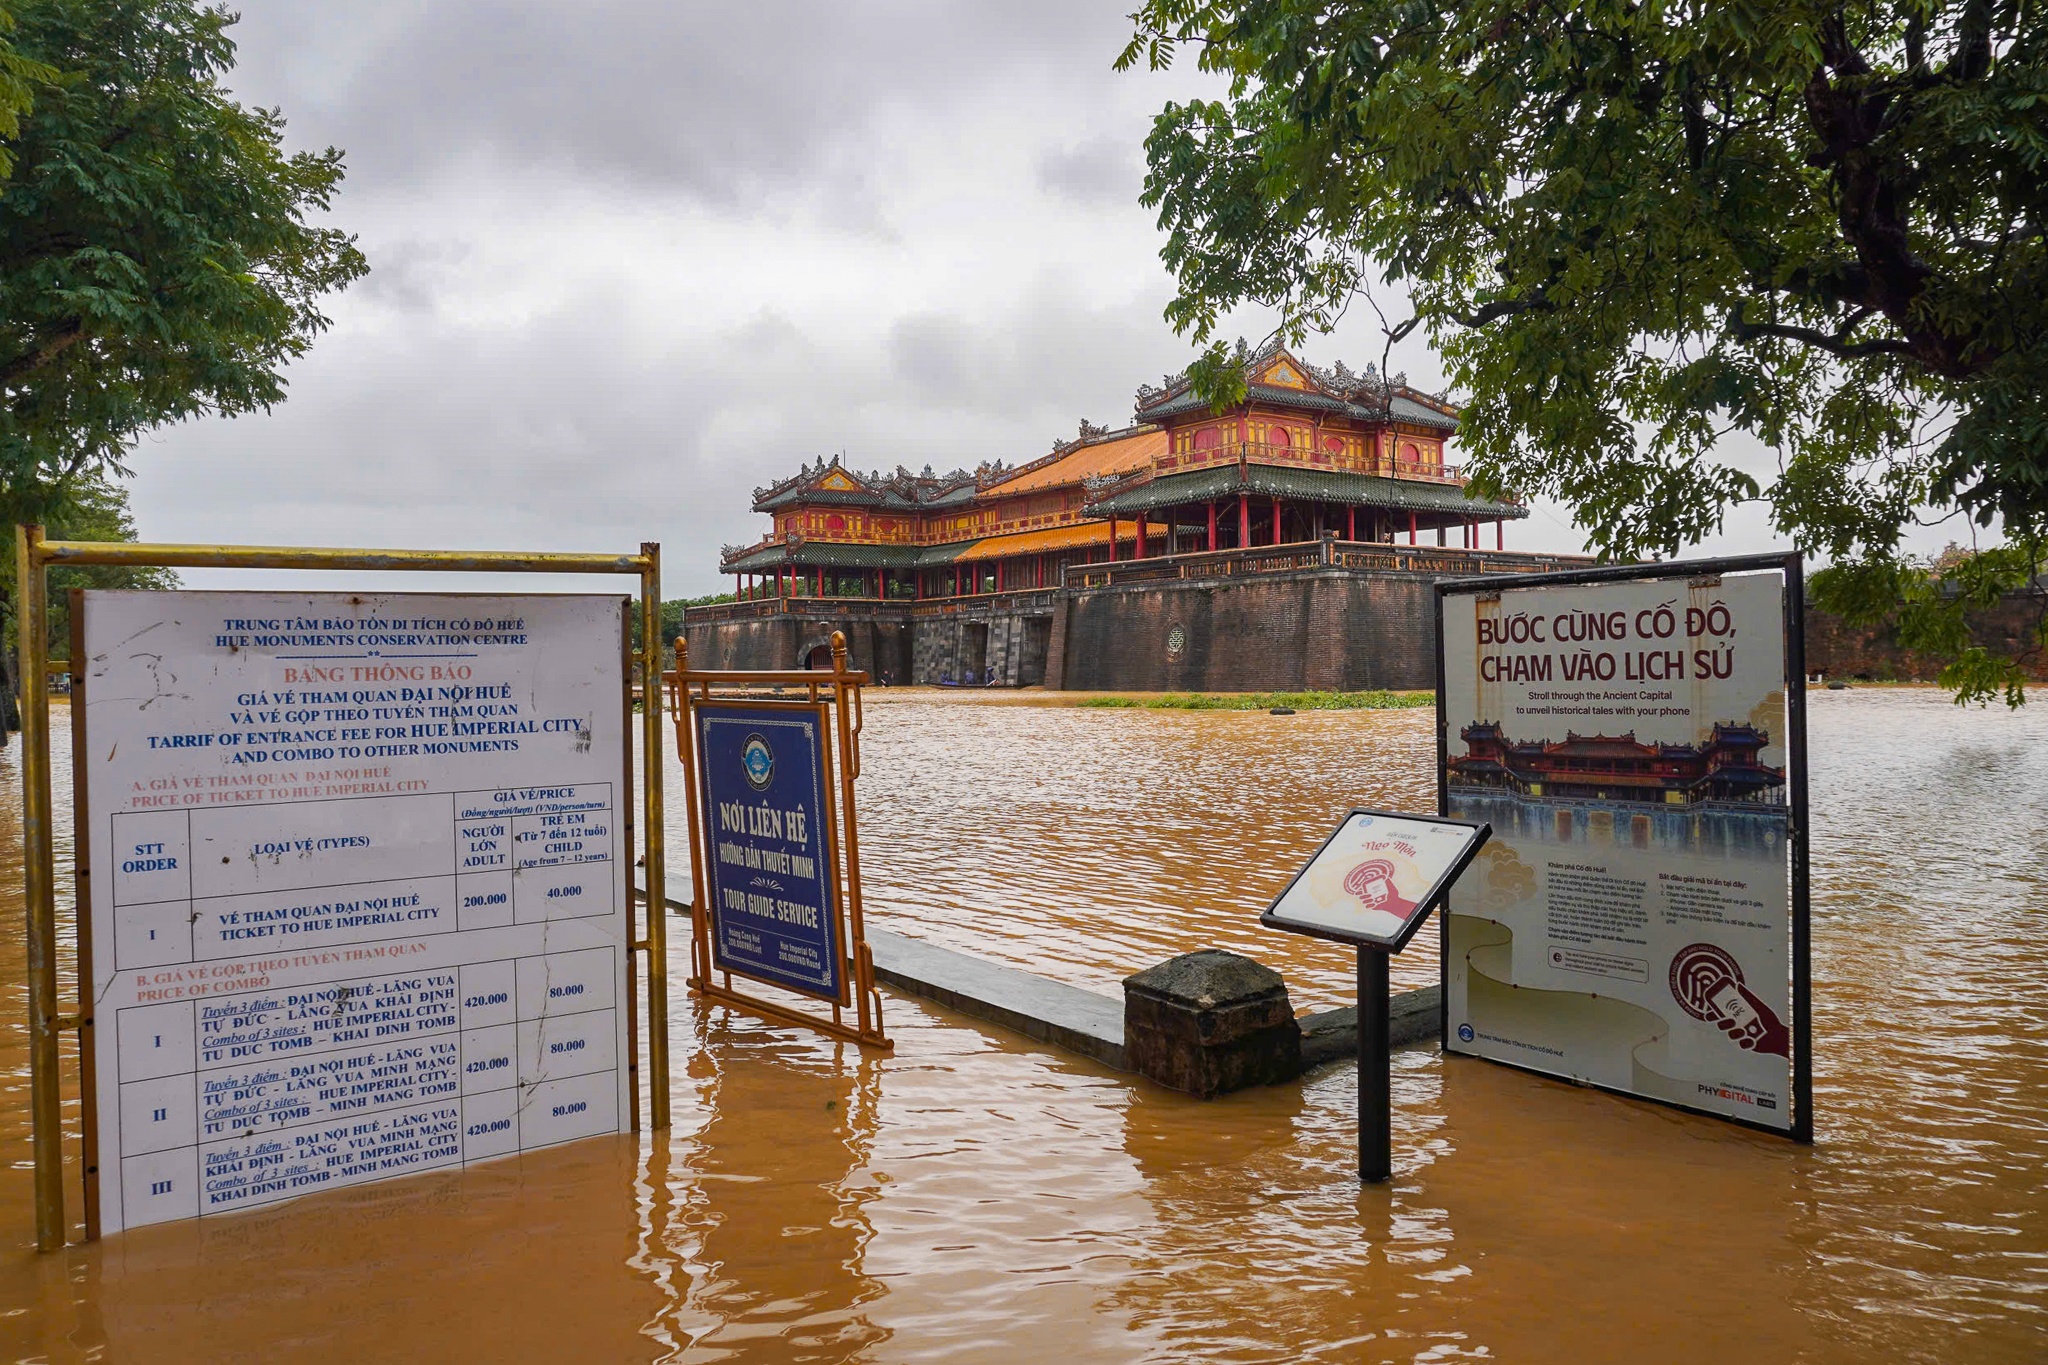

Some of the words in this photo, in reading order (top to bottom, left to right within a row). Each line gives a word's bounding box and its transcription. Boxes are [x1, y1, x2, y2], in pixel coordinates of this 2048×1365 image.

[223, 620, 280, 630] TRUNG
[284, 617, 318, 630] TÂM
[392, 619, 407, 629] DI
[411, 616, 446, 629] TÍCH
[1478, 612, 1545, 644] BƯỚC
[1552, 609, 1626, 642] CÙNG
[1635, 599, 1677, 639] CỐ
[1684, 600, 1736, 638] ĐÔ,
[216, 635, 250, 646] HUE
[254, 635, 354, 645] MONUMENTS
[358, 634, 470, 645] CONSERVATION
[473, 634, 528, 644] CENTRE
[1480, 654, 1552, 684] CHẠM
[1560, 648, 1616, 681] VÀO
[1625, 650, 1684, 684] LỊCH
[1694, 642, 1734, 680] SỬ
[350, 663, 427, 682] THÔNG
[430, 662, 472, 680] BÁO
[238, 690, 268, 705] GIÁ
[273, 689, 295, 704] VÉ
[299, 691, 348, 703] THAM
[352, 690, 396, 702] QUAN
[1528, 691, 1550, 700] Stroll
[1551, 691, 1586, 702] through
[1588, 691, 1600, 700] the
[1602, 691, 1637, 700] Ancient
[1639, 690, 1672, 702] Capital
[230, 709, 253, 723] VÀ
[258, 708, 281, 722] VÉ
[324, 709, 369, 720] THEO
[428, 705, 474, 717] THAM
[476, 704, 517, 715] QUAN
[1526, 706, 1550, 714] unveil
[1552, 706, 1590, 715] historical
[1592, 706, 1614, 715] tales
[1616, 706, 1634, 715] with
[1636, 708, 1658, 717] your
[1660, 706, 1690, 717] phone
[147, 734, 215, 748] TARRIF
[219, 733, 242, 745] OF
[247, 729, 337, 744] ENTRANCE
[342, 728, 371, 740] FEE
[375, 726, 407, 739] FOR
[411, 725, 448, 737] HUE
[451, 721, 539, 736] IMPERIAL
[543, 719, 585, 732] CITY
[232, 751, 268, 763] AND
[272, 748, 335, 761] COMBO
[338, 747, 361, 758] TO
[364, 744, 419, 757] OTHER
[422, 740, 519, 754] MONUMENTS
[131, 794, 179, 807] PRICE
[181, 793, 204, 804] OF
[208, 790, 264, 802] TICKET
[268, 788, 289, 799] TO
[293, 786, 322, 798] HUE
[325, 782, 395, 796] IMPERIAL
[397, 780, 429, 792] CITY
[494, 789, 516, 802] GIÁ
[566, 815, 585, 824] EM
[719, 800, 745, 833] NƠI
[748, 800, 782, 839] LIÊN
[786, 803, 808, 851] HỆ
[541, 831, 546, 839] 7
[571, 829, 581, 837] 12
[135, 843, 165, 855] STT
[294, 837, 313, 851] VÉ
[317, 835, 370, 852] (TYPES)
[545, 842, 583, 853] CHILD
[122, 859, 178, 872] ORDER
[463, 854, 505, 867] ADULT
[539, 856, 558, 865] from
[575, 854, 583, 862] 12
[792, 855, 814, 880] MINH
[547, 885, 582, 898] 40.000
[464, 894, 507, 907] 200.000
[724, 887, 746, 911] TOUR
[748, 893, 774, 918] GUIDE
[777, 898, 818, 929] SERVICE
[220, 926, 276, 940] TICKET
[279, 923, 300, 934] TO
[303, 920, 333, 932] HUE
[337, 913, 404, 928] IMPERIAL
[407, 909, 439, 921] CITY
[137, 986, 185, 1001] PRICE
[189, 983, 210, 995] OF
[212, 976, 270, 992] COMBO
[550, 984, 584, 998] 80.000
[464, 993, 508, 1008] 420.000
[551, 1040, 585, 1053] 80.000
[466, 1057, 509, 1072] 420.000
[553, 1103, 586, 1116] 80.000
[467, 1121, 510, 1136] 420.000
